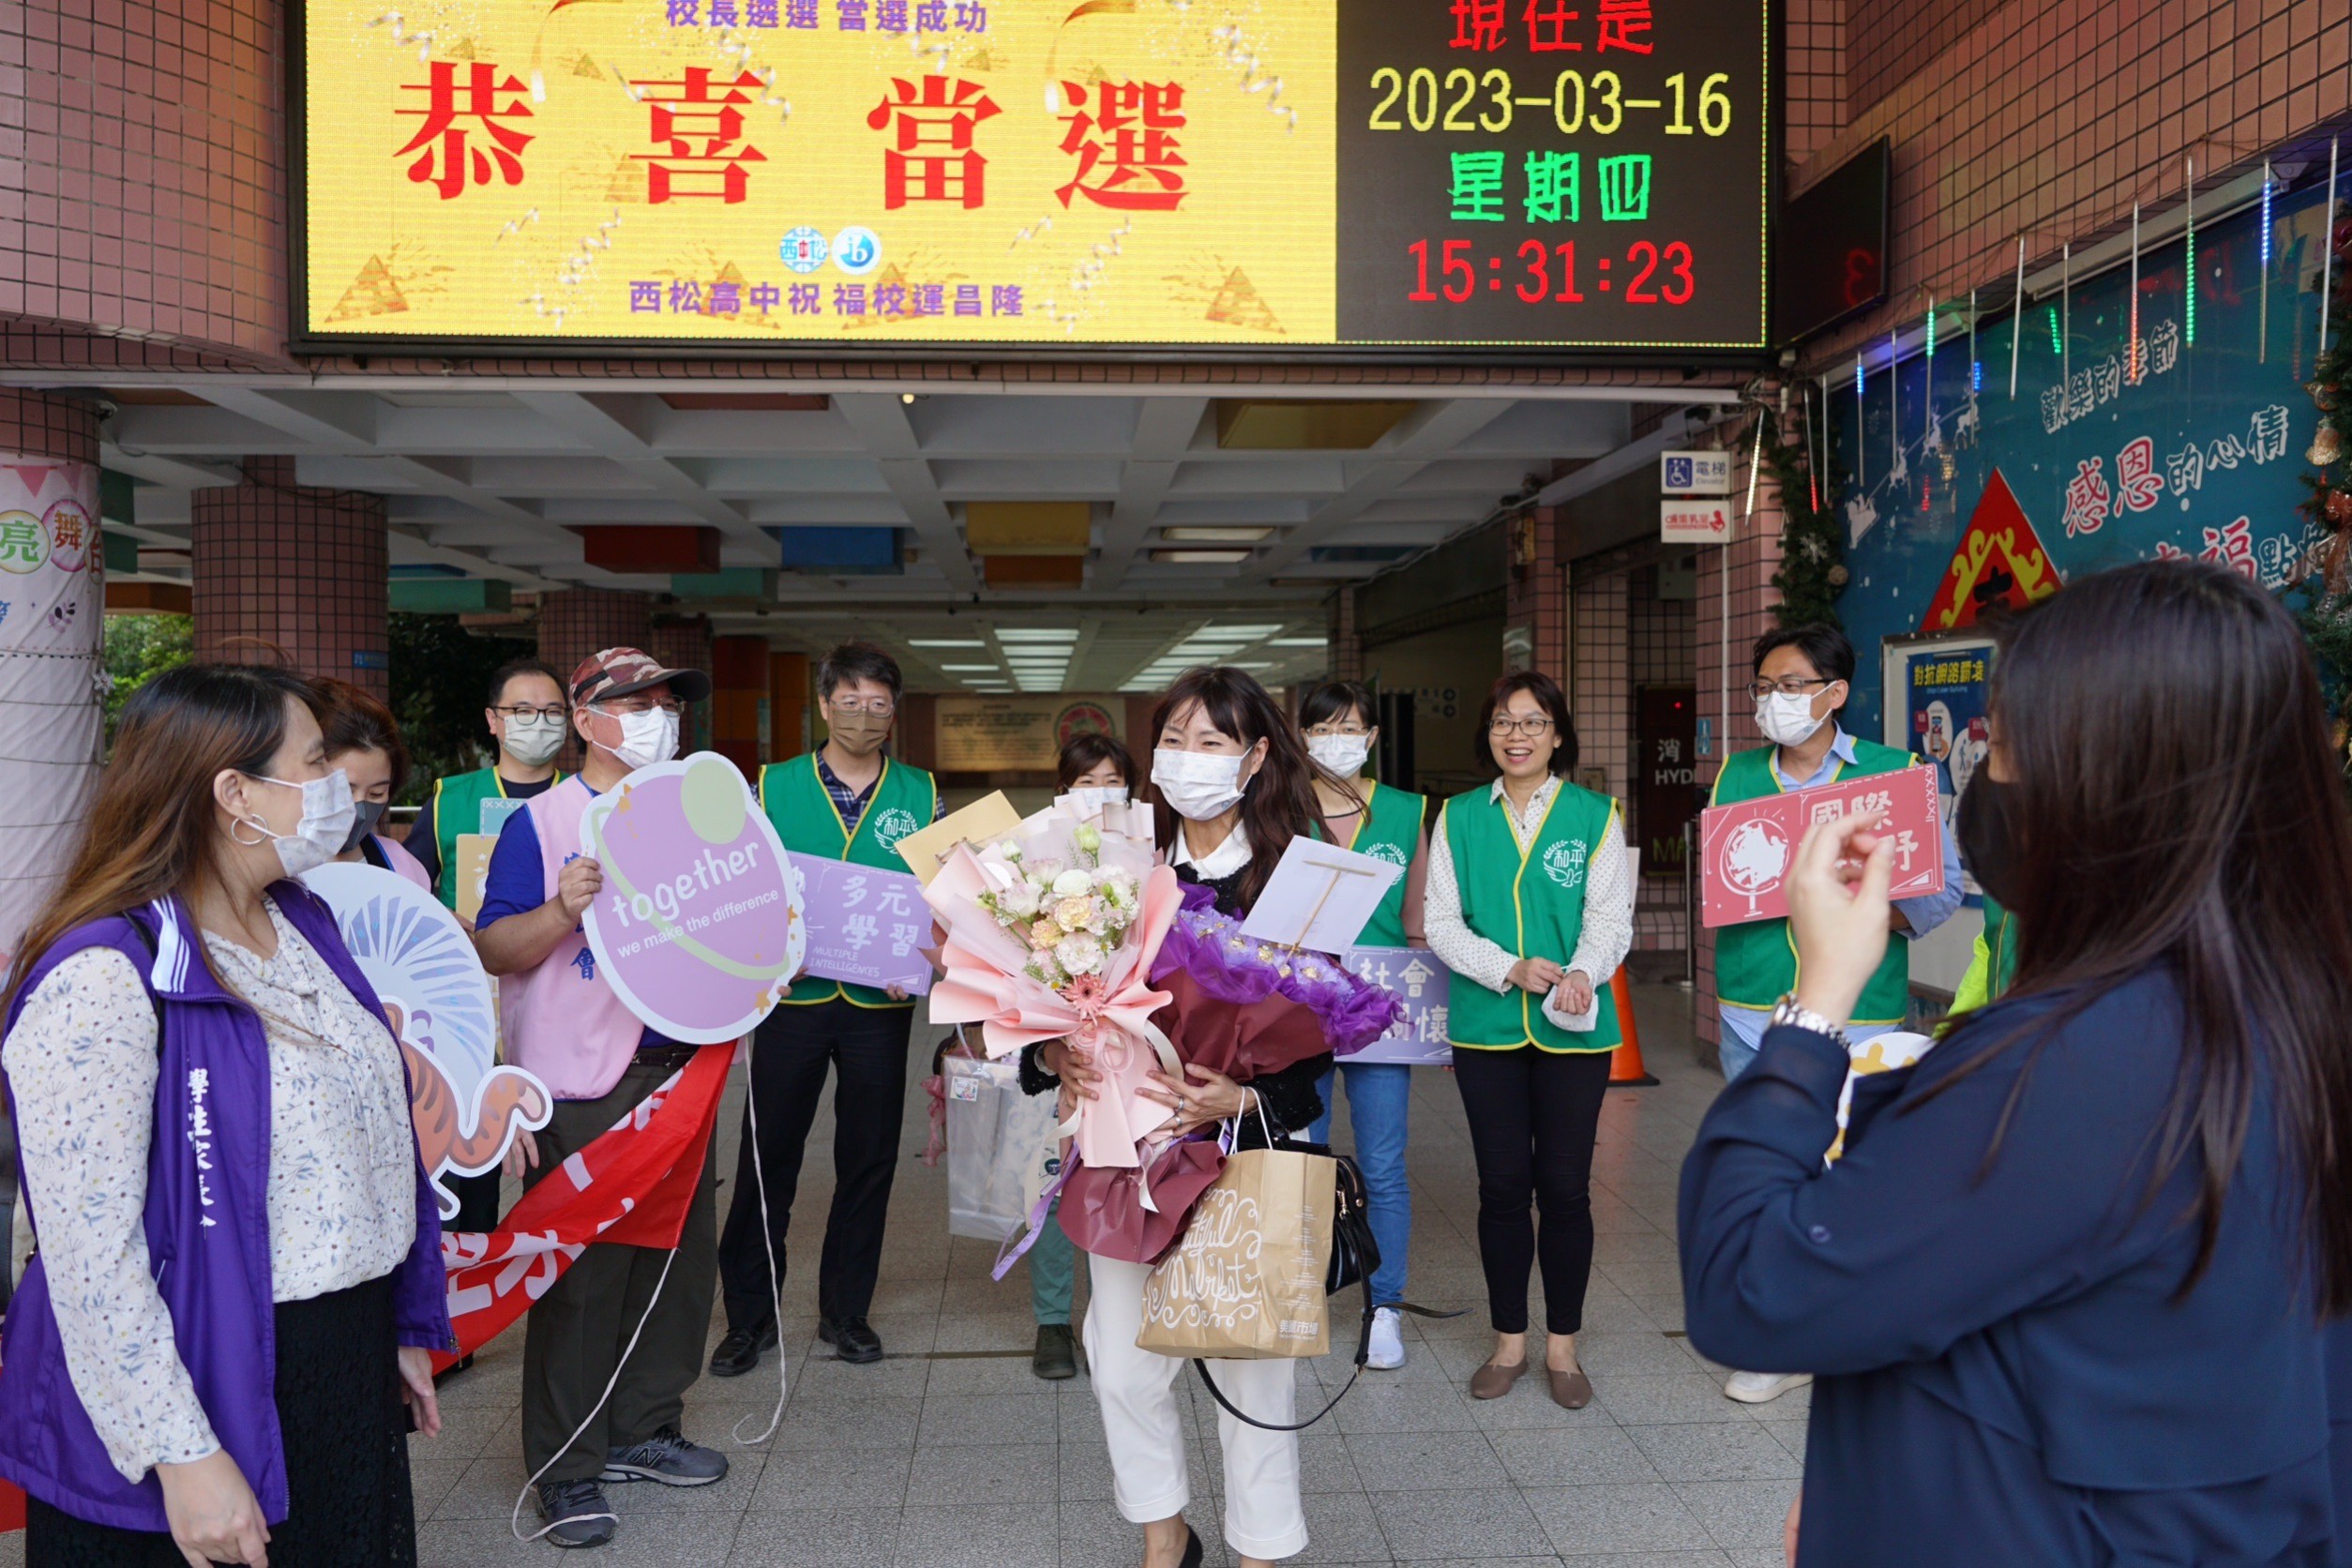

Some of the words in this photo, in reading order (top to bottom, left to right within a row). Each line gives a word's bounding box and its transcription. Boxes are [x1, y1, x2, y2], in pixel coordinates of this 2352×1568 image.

[837, 0, 987, 33] 當選成功
[1448, 0, 1655, 54] 現在是
[1369, 68, 1732, 137] 2023-03-16
[393, 60, 1191, 212] 恭喜當選
[1447, 150, 1652, 223] 星期四
[1408, 238, 1695, 306] 15:31:23
[629, 280, 1025, 317] 西松高中祝福校運昌隆
[2061, 404, 2289, 539] 感恩的心情
[1913, 659, 1984, 686] 對抗網路霸凌
[1553, 849, 1585, 869] 和平
[611, 842, 759, 927] together
[841, 874, 912, 917] 多元
[617, 940, 641, 957] we
[643, 925, 685, 949] make
[686, 914, 711, 932] the
[712, 889, 779, 923] difference
[841, 912, 920, 957] 學習
[810, 958, 881, 977] INTELLIGENCES
[812, 946, 859, 961] MULTIPLE
